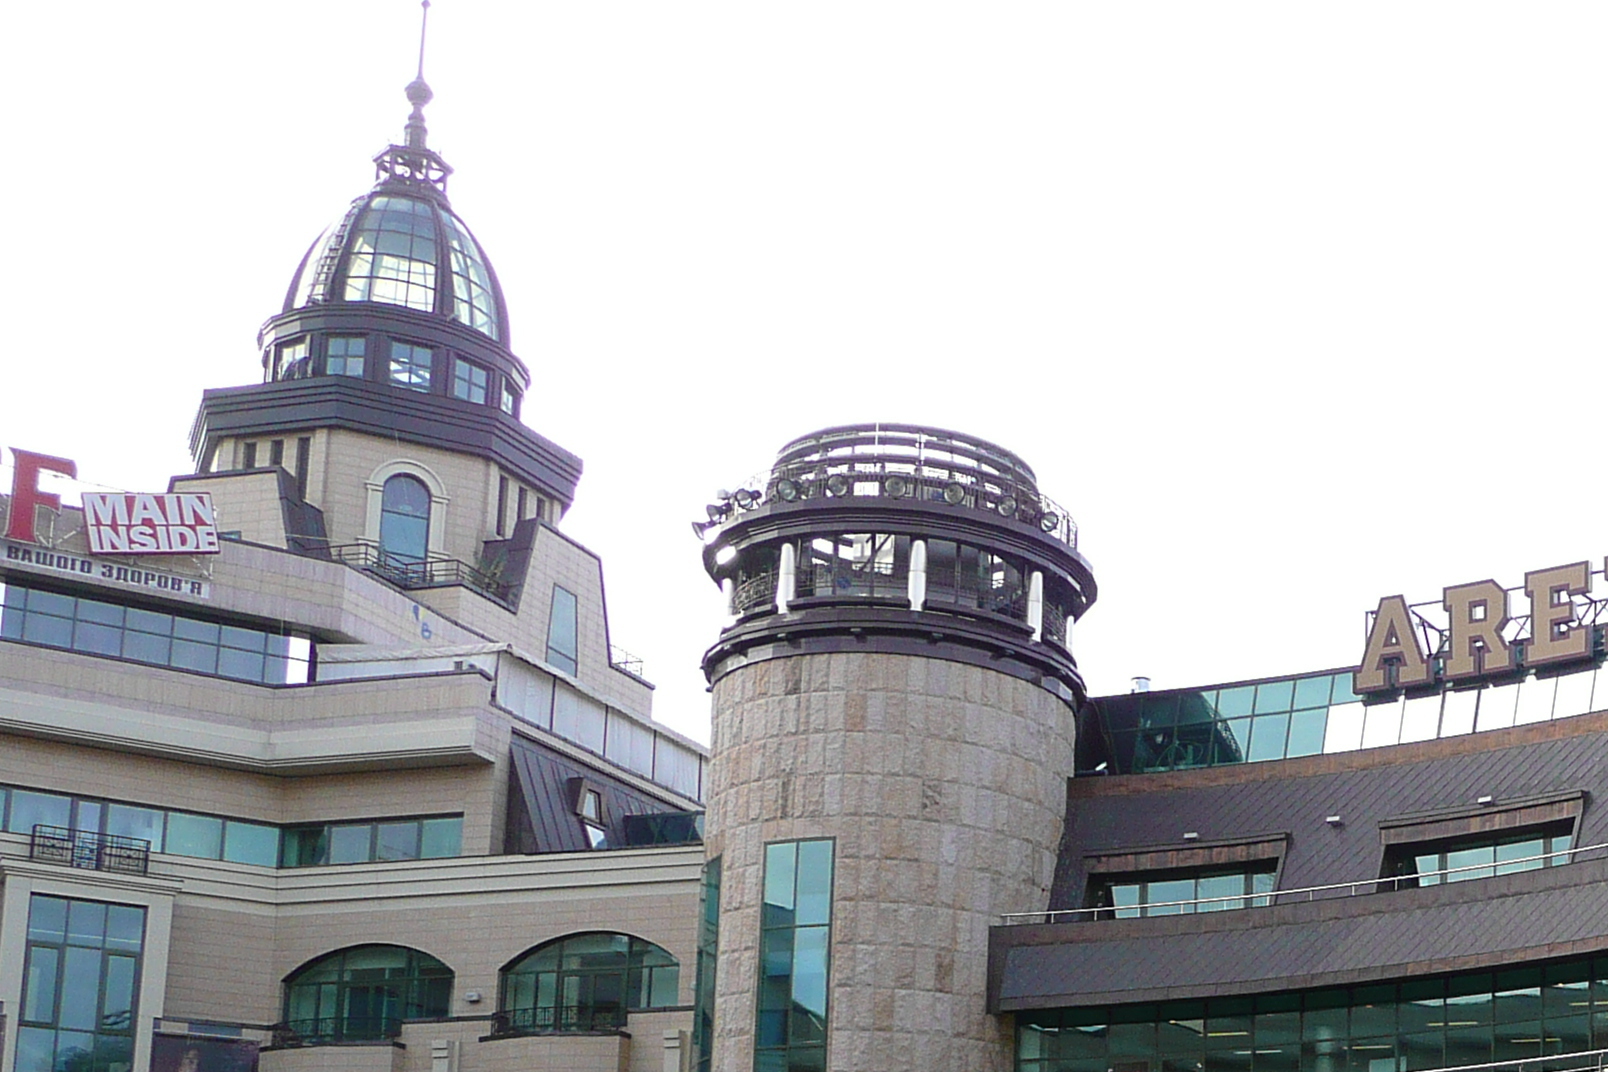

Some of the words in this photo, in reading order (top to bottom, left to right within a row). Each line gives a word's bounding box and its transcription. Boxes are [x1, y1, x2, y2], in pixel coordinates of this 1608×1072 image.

[83, 493, 213, 526] MAIN
[88, 525, 218, 551] INSIDE
[7, 545, 93, 575] ВАШОГО
[101, 563, 203, 596] ЗДОРОВ'Я
